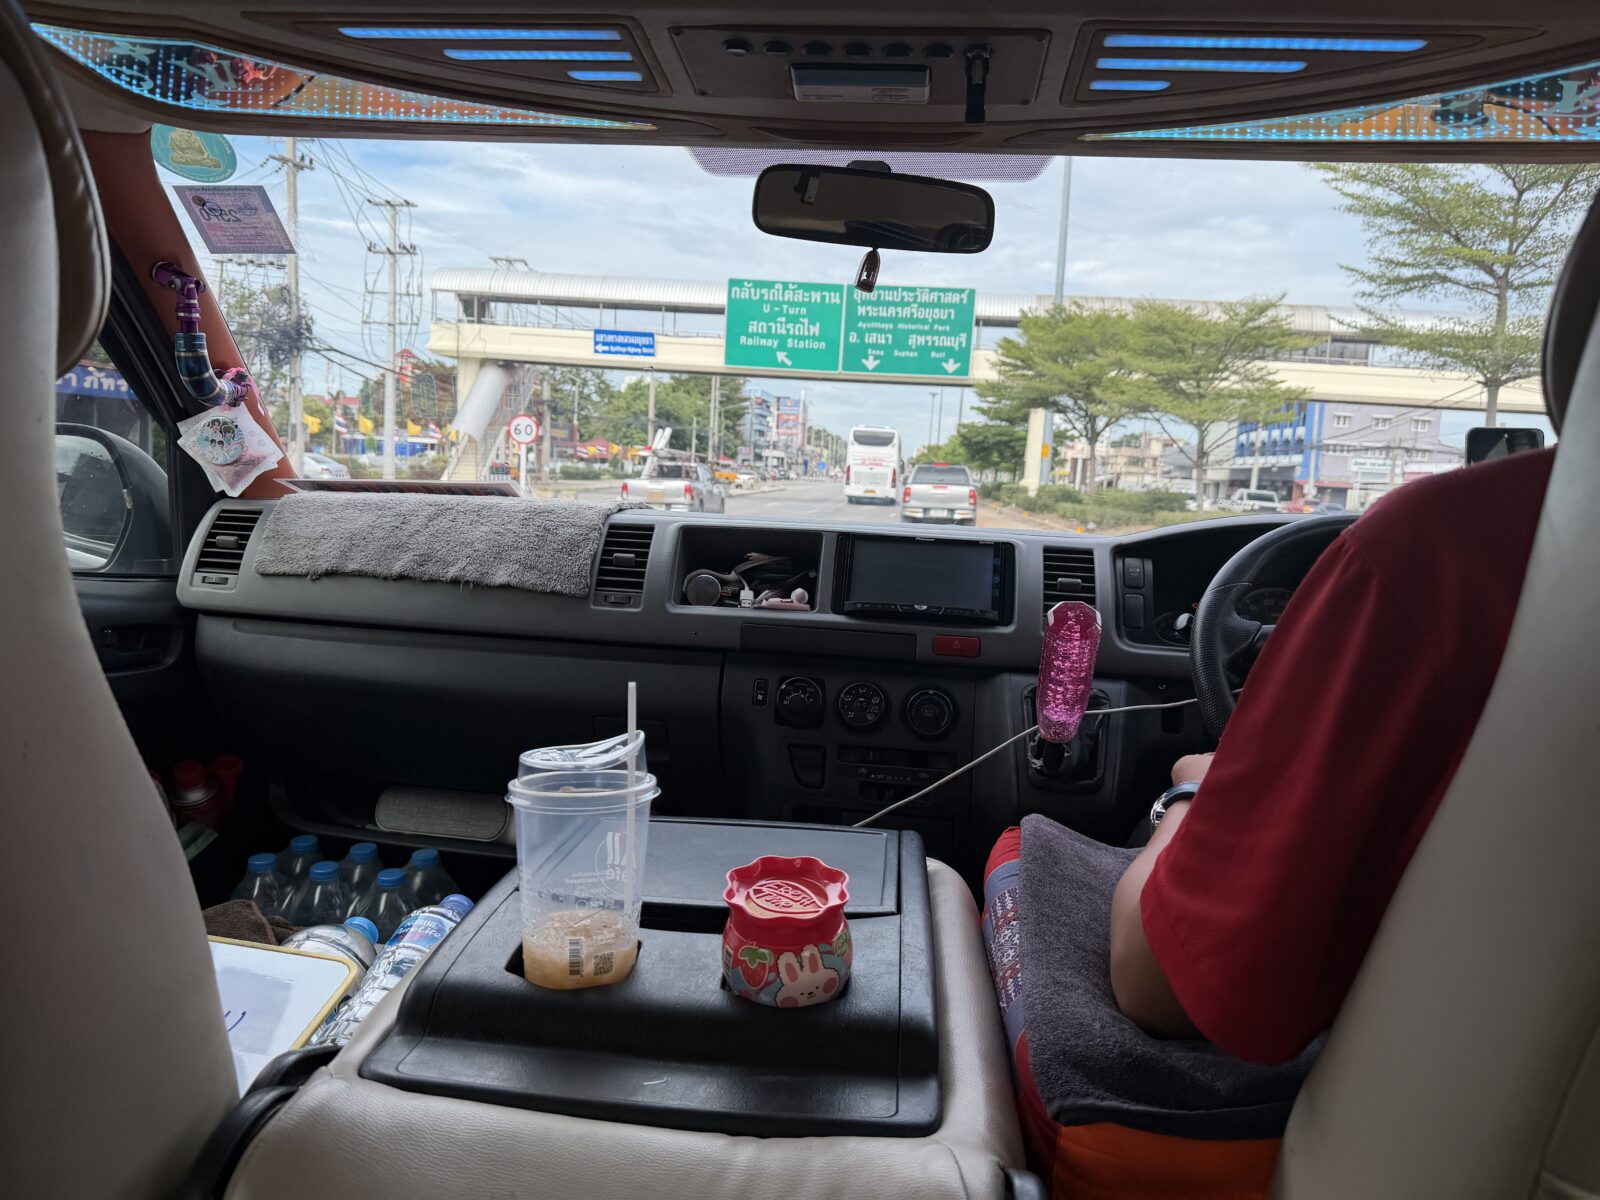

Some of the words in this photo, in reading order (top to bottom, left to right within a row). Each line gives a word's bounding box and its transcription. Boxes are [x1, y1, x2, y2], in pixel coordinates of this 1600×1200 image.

[730, 281, 841, 305] กลับรถใต้สะพาน
[782, 304, 807, 315] Turn
[748, 316, 820, 337] สถานีรถไฟ
[739, 335, 779, 349] Railway
[786, 337, 826, 350] Station
[864, 331, 893, 345] เสนา
[908, 332, 968, 351] สุพรรณบุรี
[514, 423, 533, 437] 60
